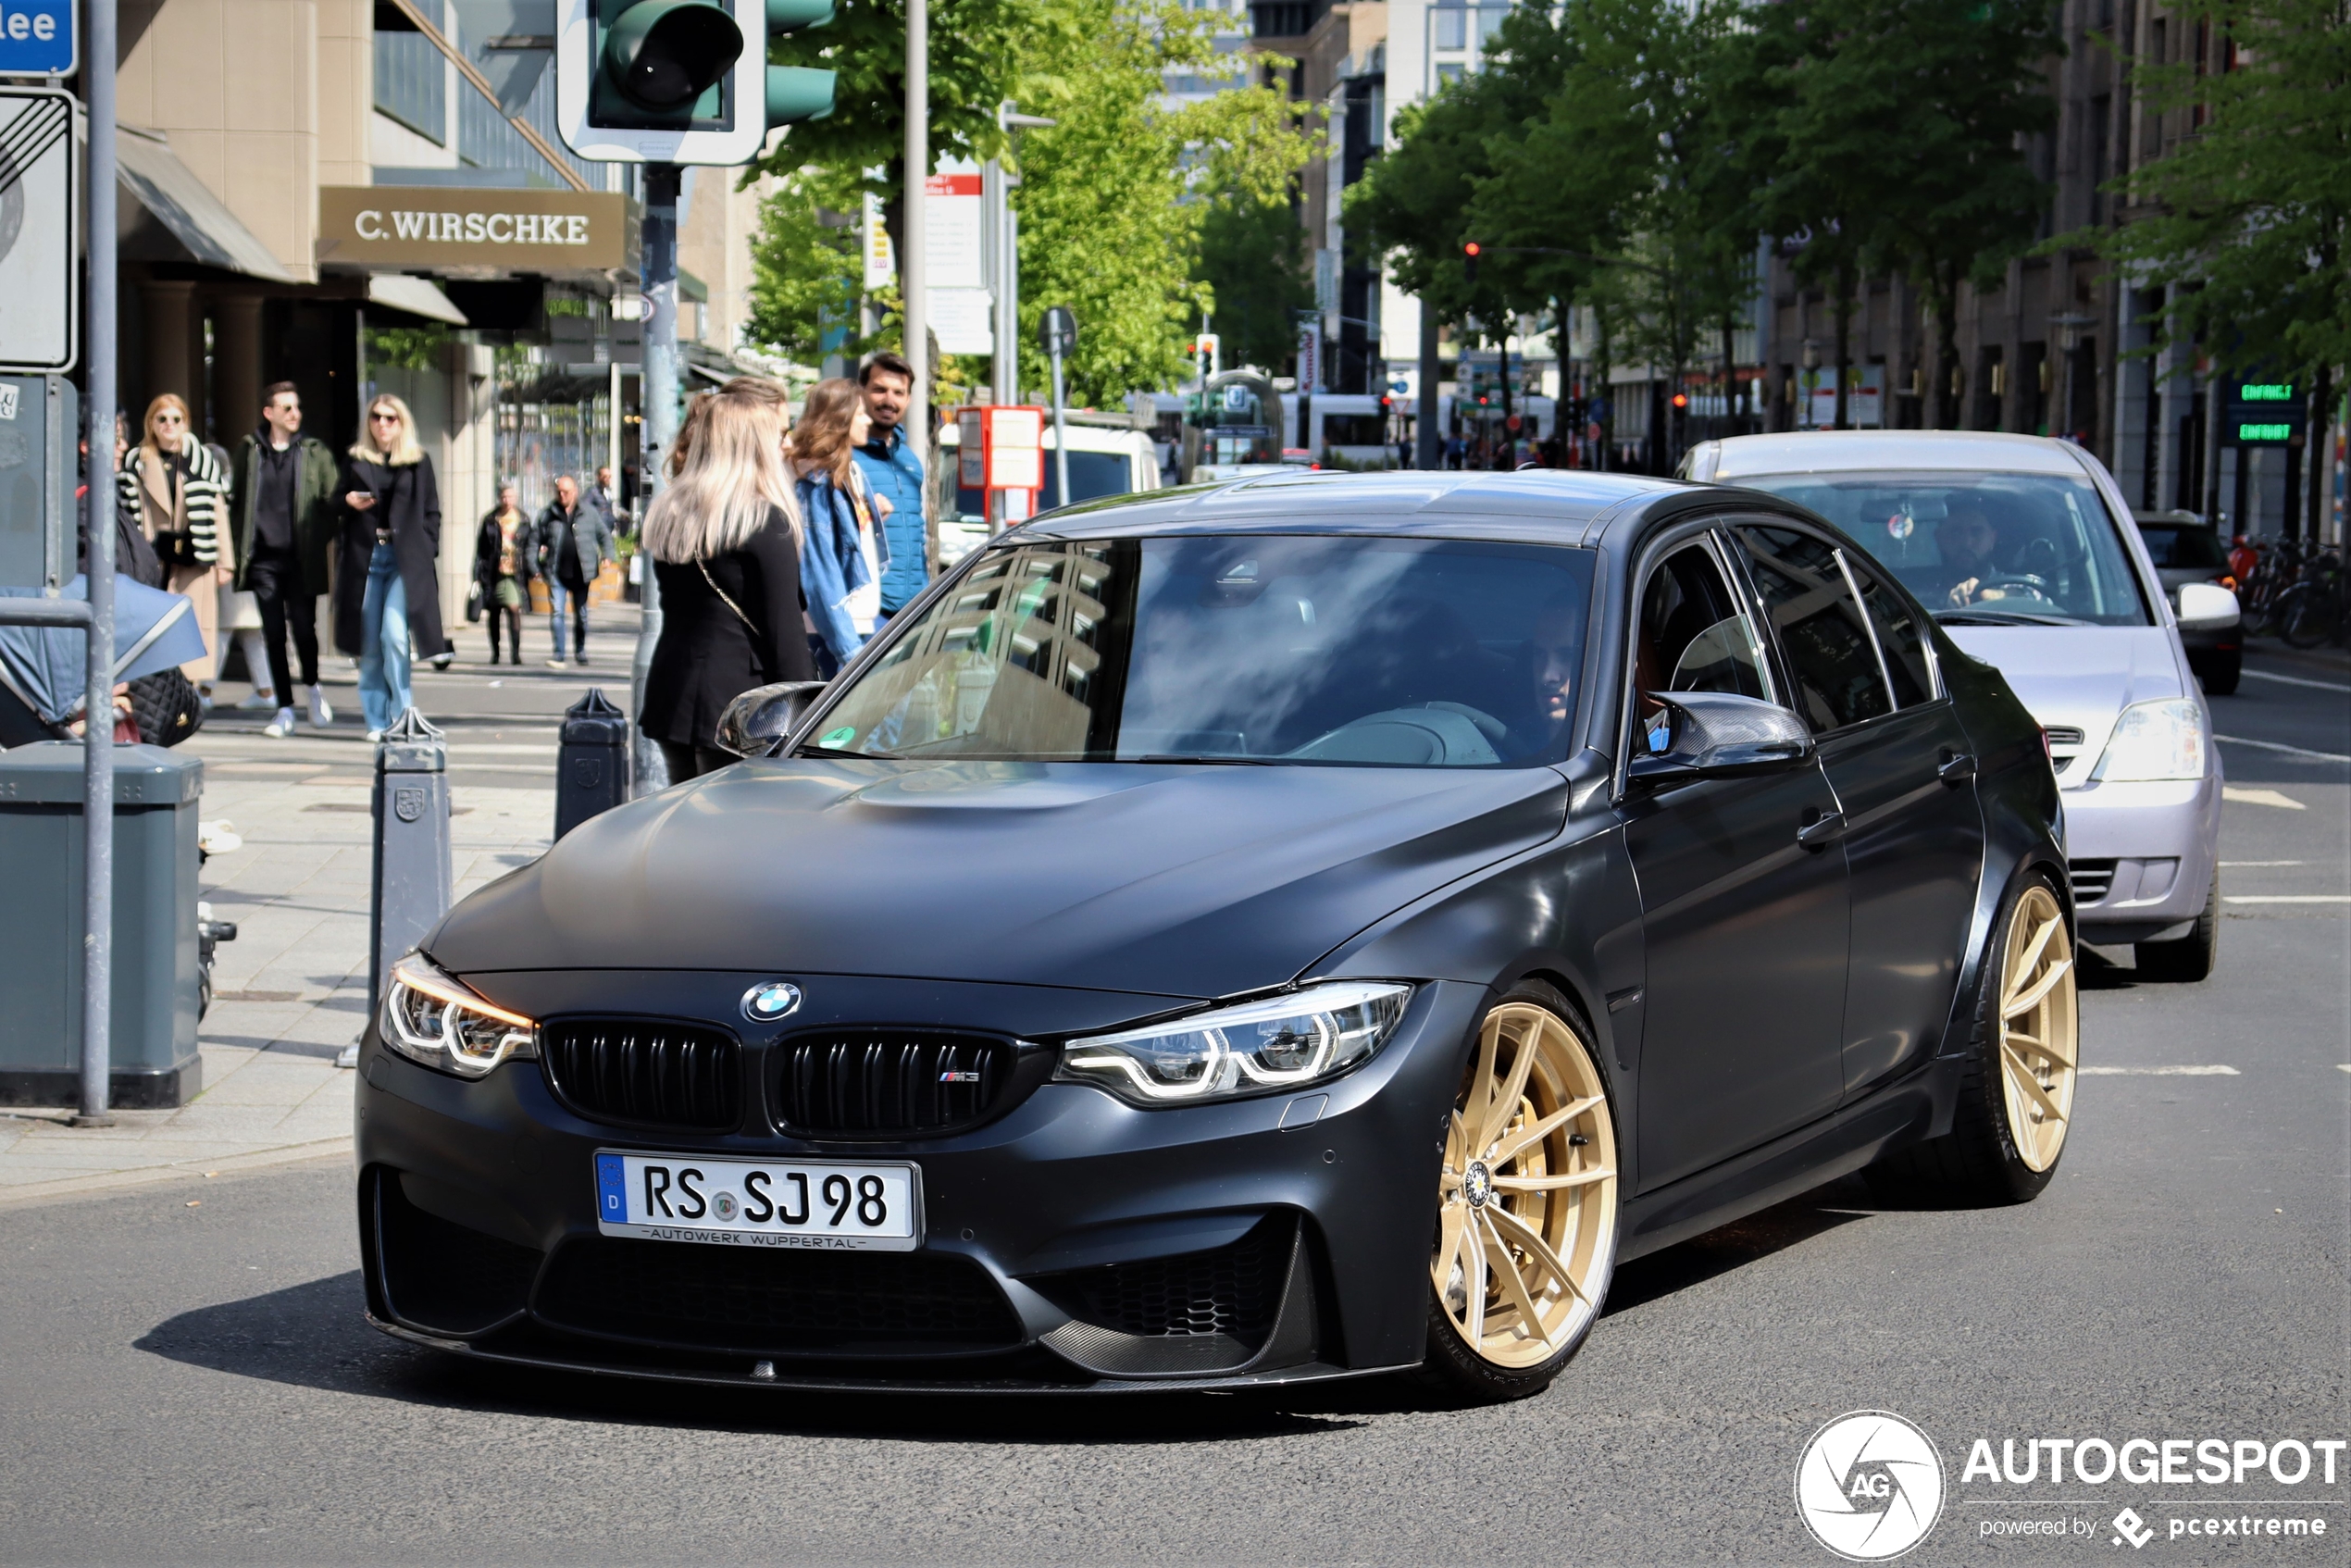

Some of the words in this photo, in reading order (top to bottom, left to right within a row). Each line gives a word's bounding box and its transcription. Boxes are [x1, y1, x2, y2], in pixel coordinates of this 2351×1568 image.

[355, 209, 589, 244] C.WIRSCHKE
[833, 728, 848, 739] 4
[951, 1072, 979, 1082] M3
[644, 1165, 707, 1219] RS
[608, 1194, 618, 1209] D
